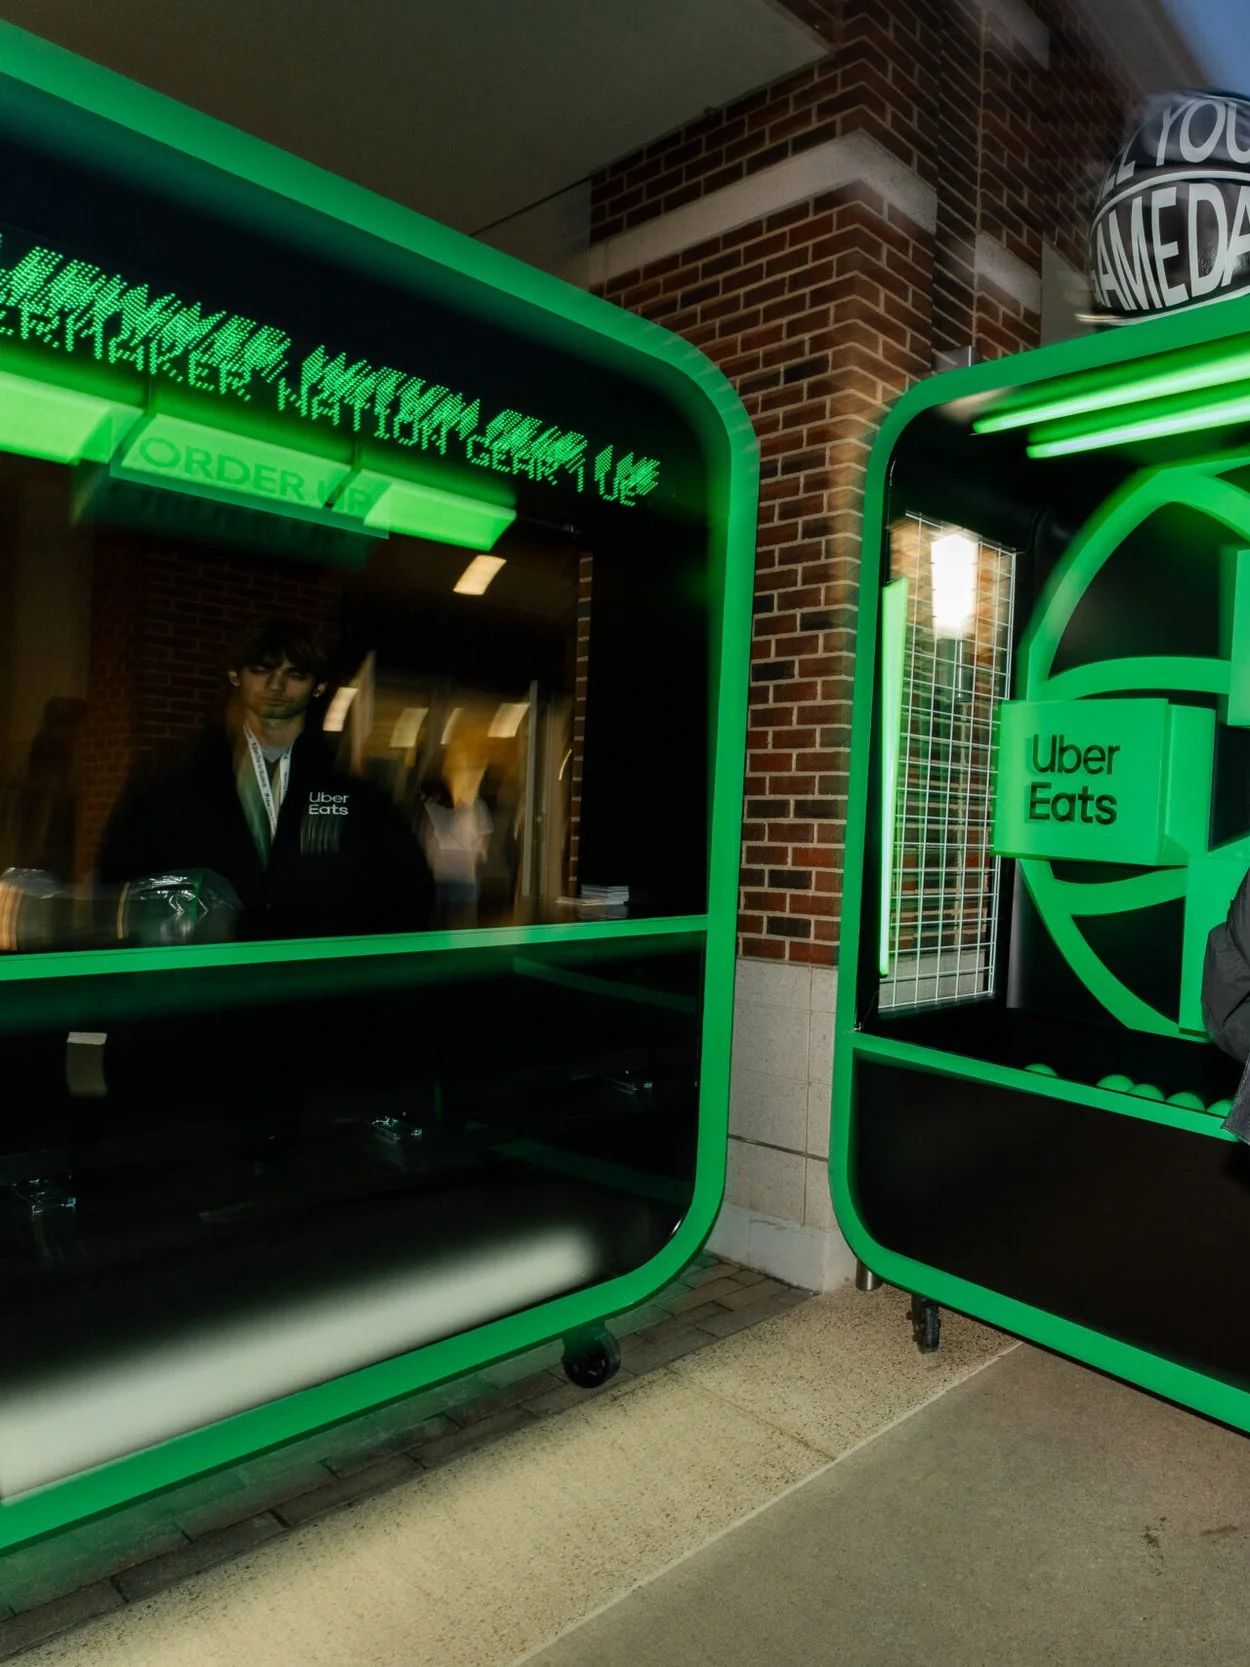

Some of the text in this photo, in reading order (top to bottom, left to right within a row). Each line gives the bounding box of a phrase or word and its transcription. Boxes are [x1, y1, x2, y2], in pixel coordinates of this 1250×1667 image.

[139, 437, 307, 502] ORDER
[1032, 733, 1120, 775] Uber
[308, 791, 350, 804] Uber
[308, 803, 349, 816] Eats
[1028, 782, 1118, 826] Eats
